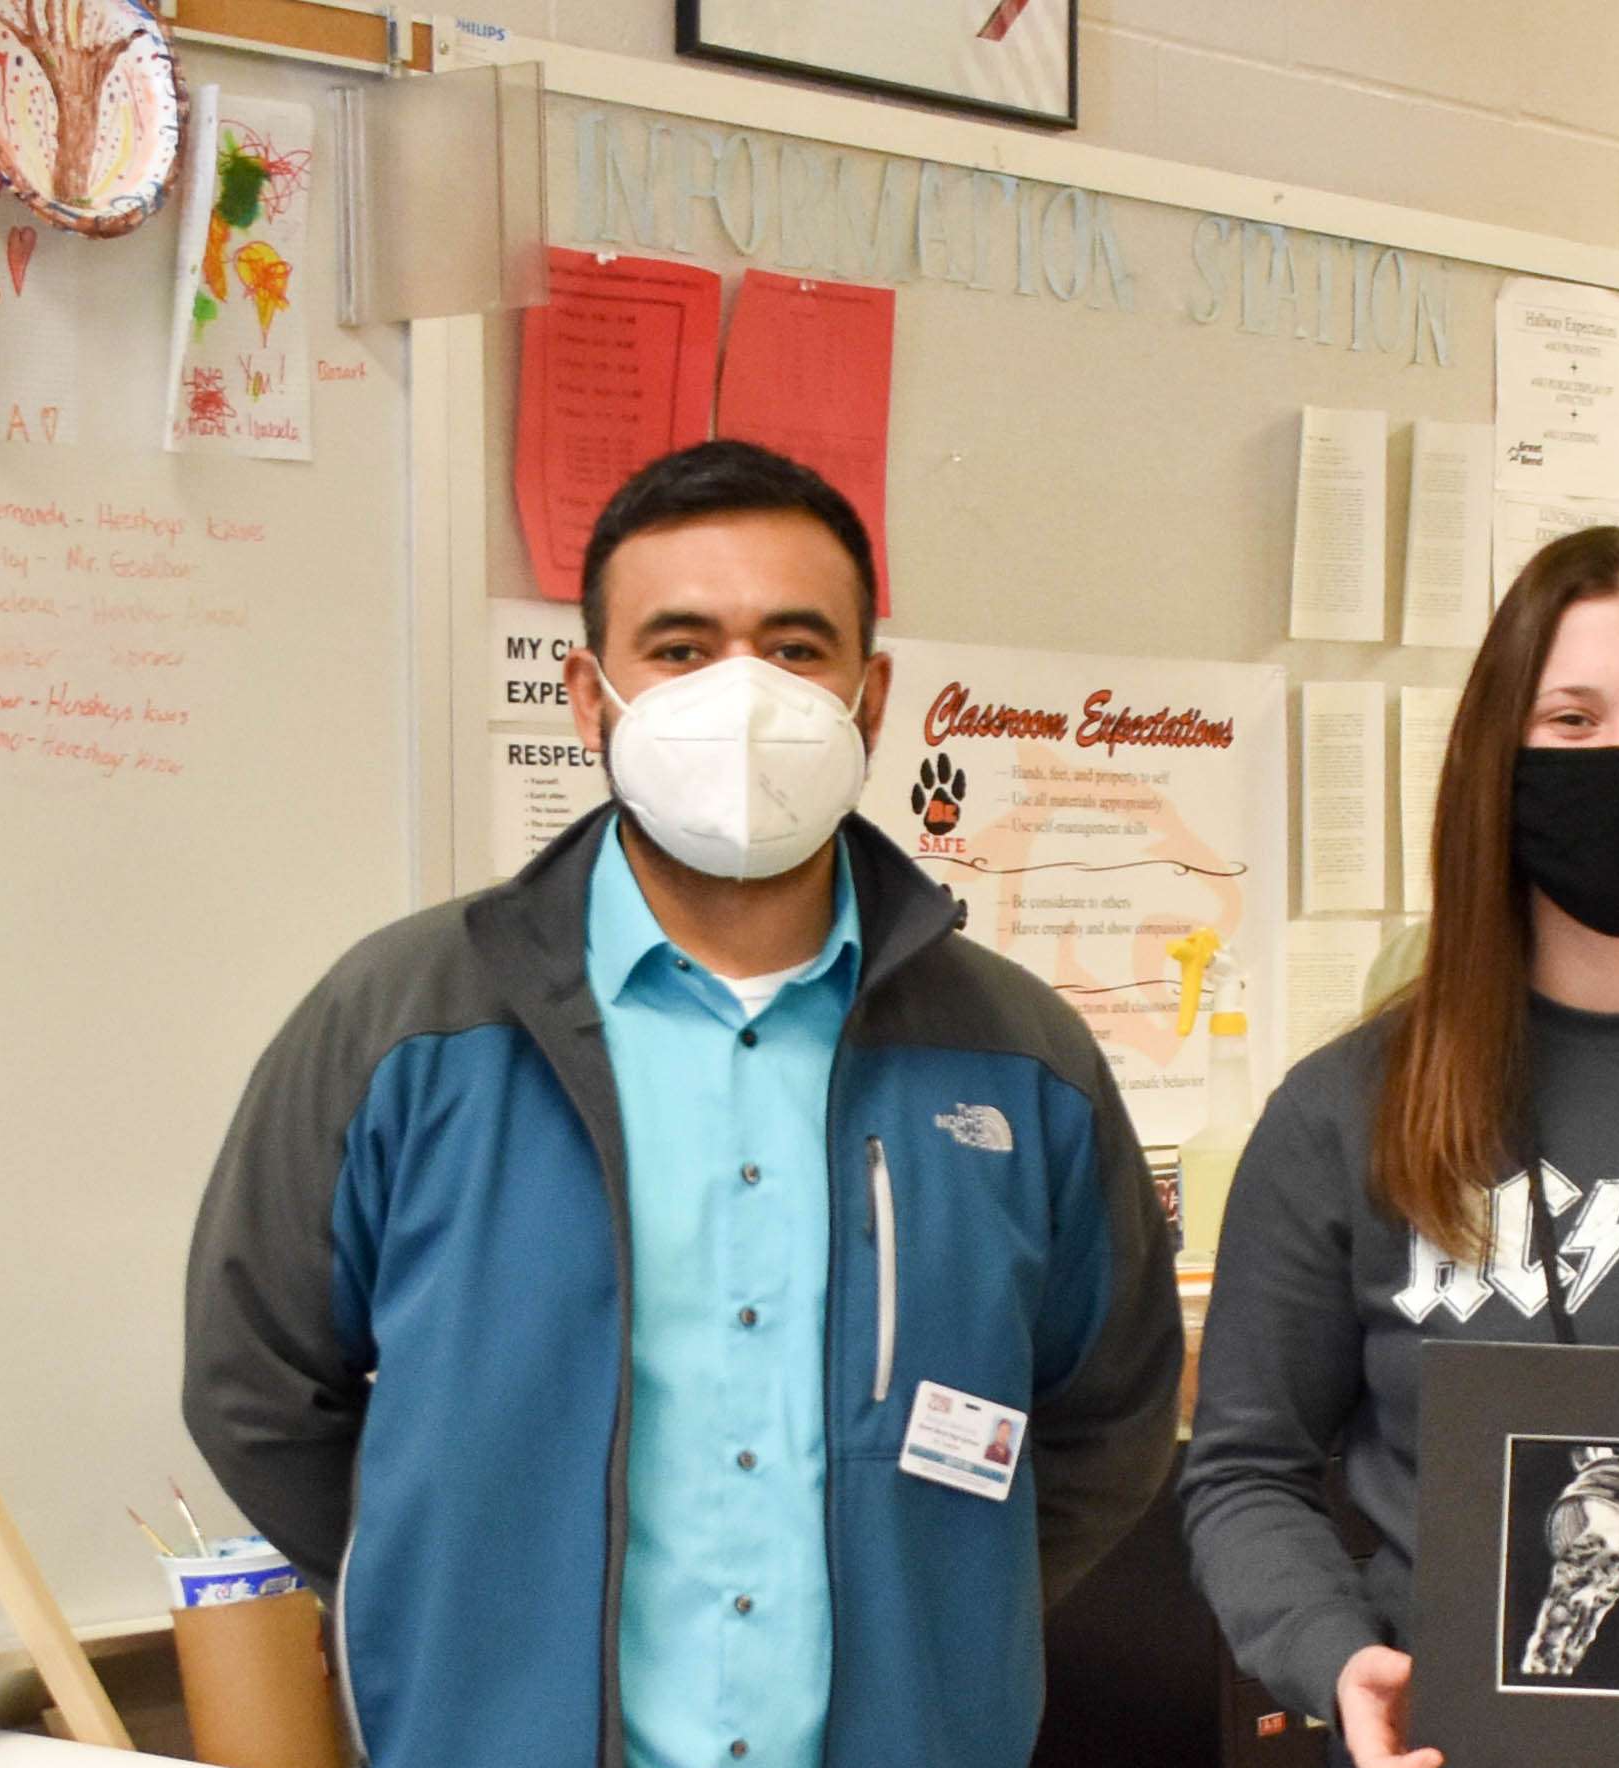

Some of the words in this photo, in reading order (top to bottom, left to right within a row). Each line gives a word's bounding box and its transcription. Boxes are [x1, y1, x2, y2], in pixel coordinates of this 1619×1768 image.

[1188, 214, 1449, 367] STATION
[507, 637, 542, 660] MY
[507, 681, 568, 705] EXPE
[924, 681, 1069, 746] Classroom
[1076, 689, 1235, 758] Expectations
[508, 744, 596, 767] RESPEC
